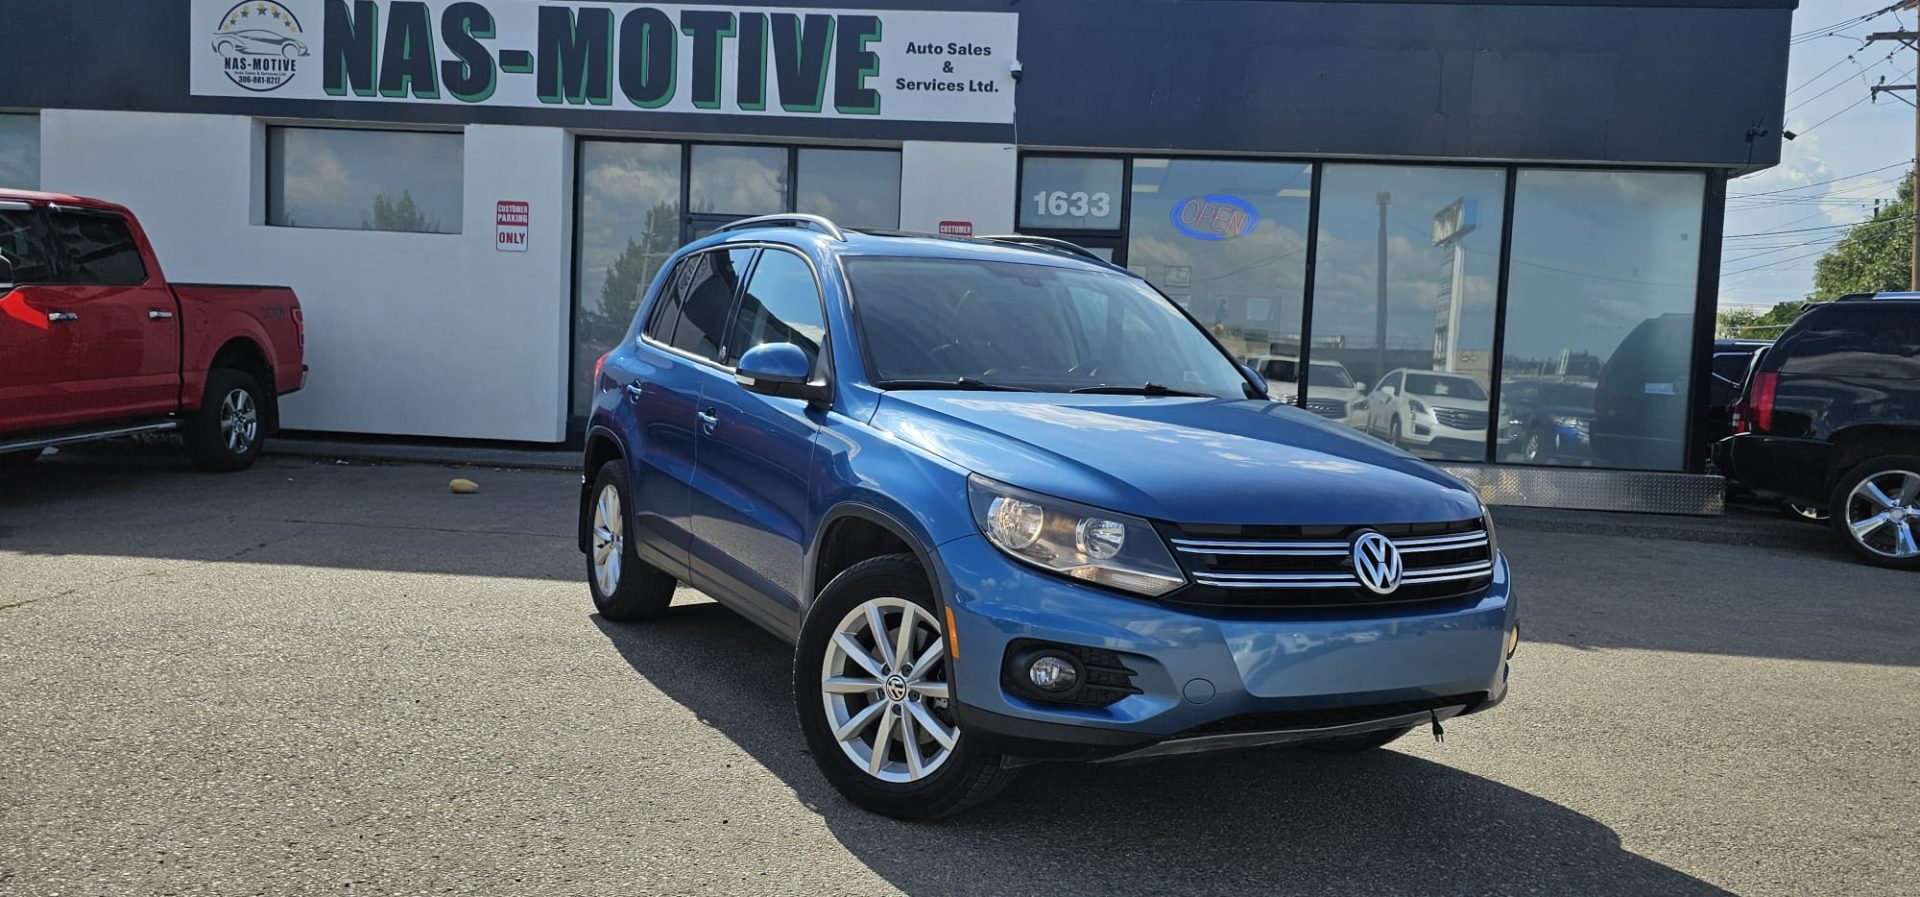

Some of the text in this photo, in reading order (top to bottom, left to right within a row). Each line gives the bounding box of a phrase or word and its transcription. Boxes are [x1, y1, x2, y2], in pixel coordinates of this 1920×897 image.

[905, 41, 992, 56] Auto Sales
[224, 57, 297, 72] NAS-MOTIVE
[323, 0, 882, 115] NAS-MOTIVE
[942, 60, 954, 73] &
[895, 78, 999, 93] Services Ltd.
[497, 204, 528, 213] CUSTOMER
[1033, 190, 1110, 218] 1633
[497, 213, 528, 223] PARKING
[1180, 199, 1247, 237] OPEN
[940, 224, 971, 235] CUSTOMER
[498, 231, 526, 245] ONLY
